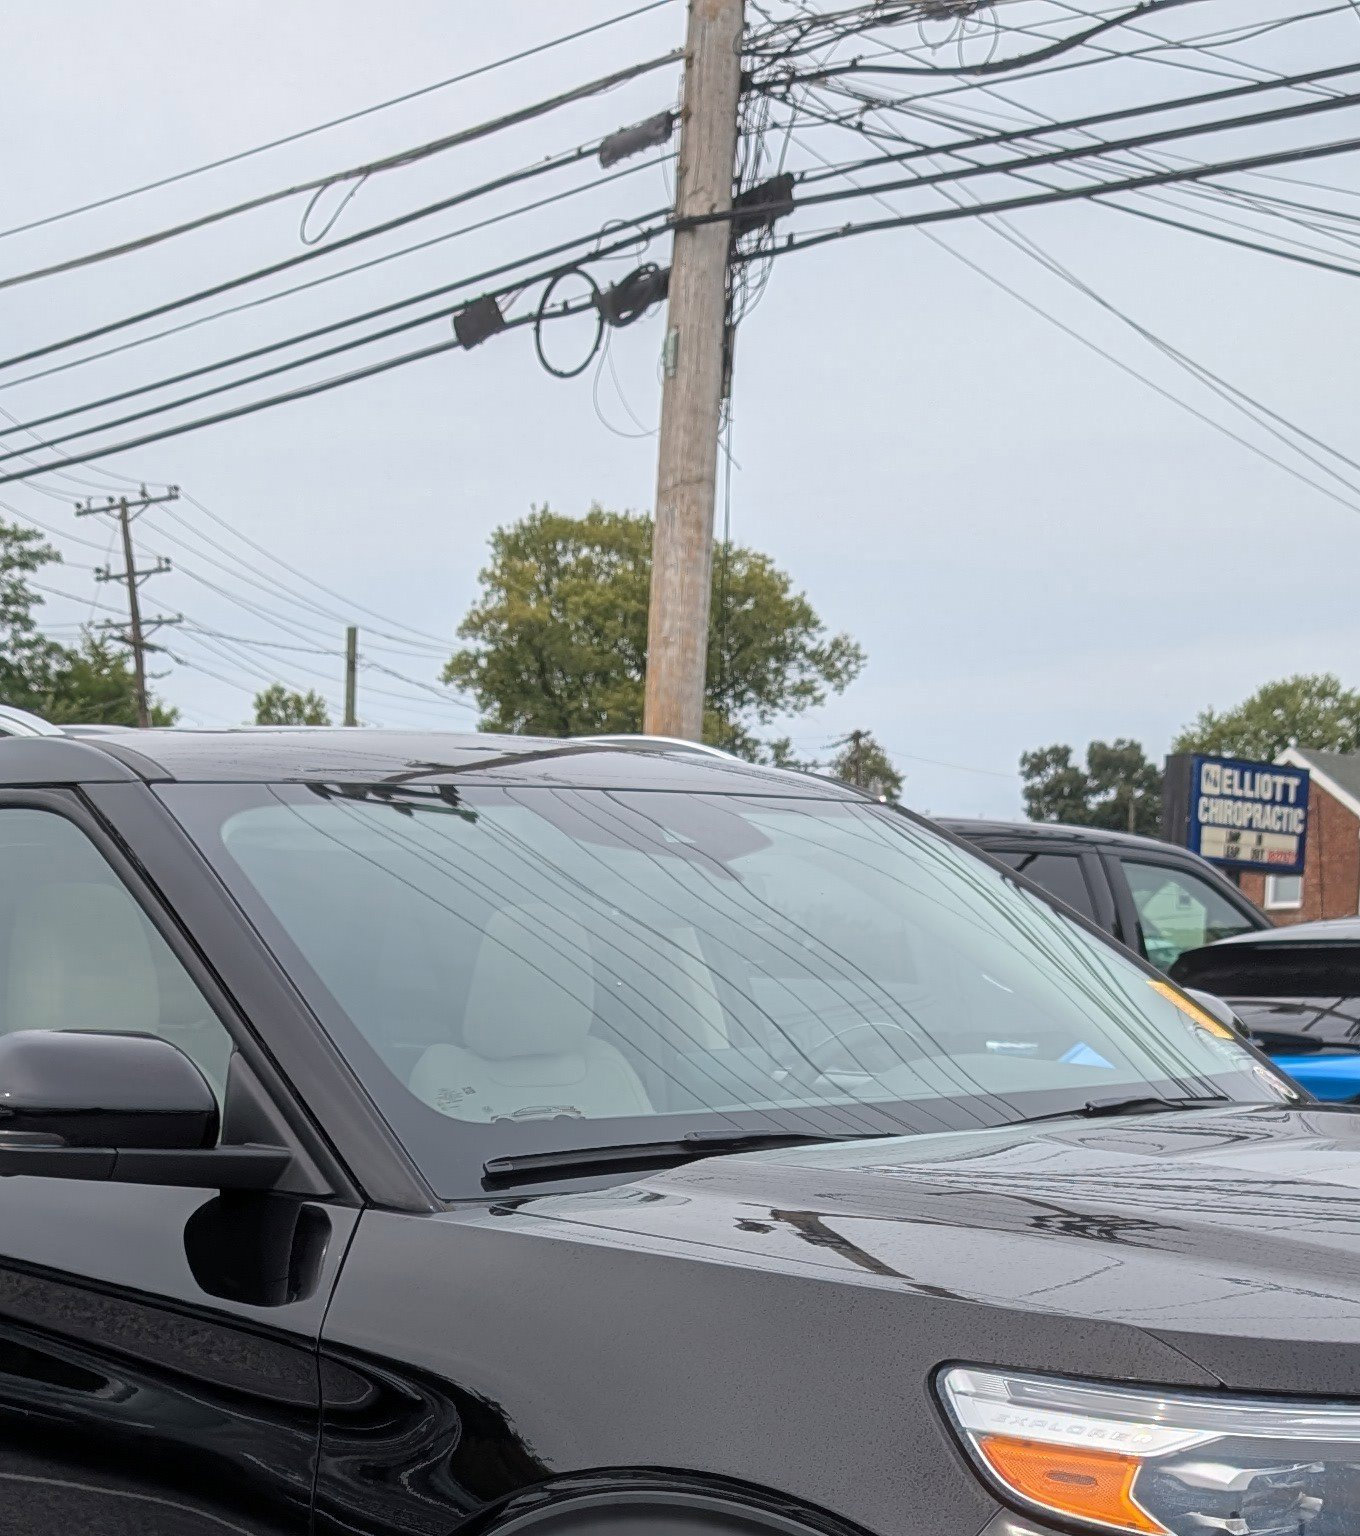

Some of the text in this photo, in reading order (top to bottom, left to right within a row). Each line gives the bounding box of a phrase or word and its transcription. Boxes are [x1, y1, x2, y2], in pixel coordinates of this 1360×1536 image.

[1221, 767, 1301, 803] ELLIOTT
[1198, 796, 1305, 834] CHIROPRACTIC
[992, 1413, 1154, 1444] EXPLORER
